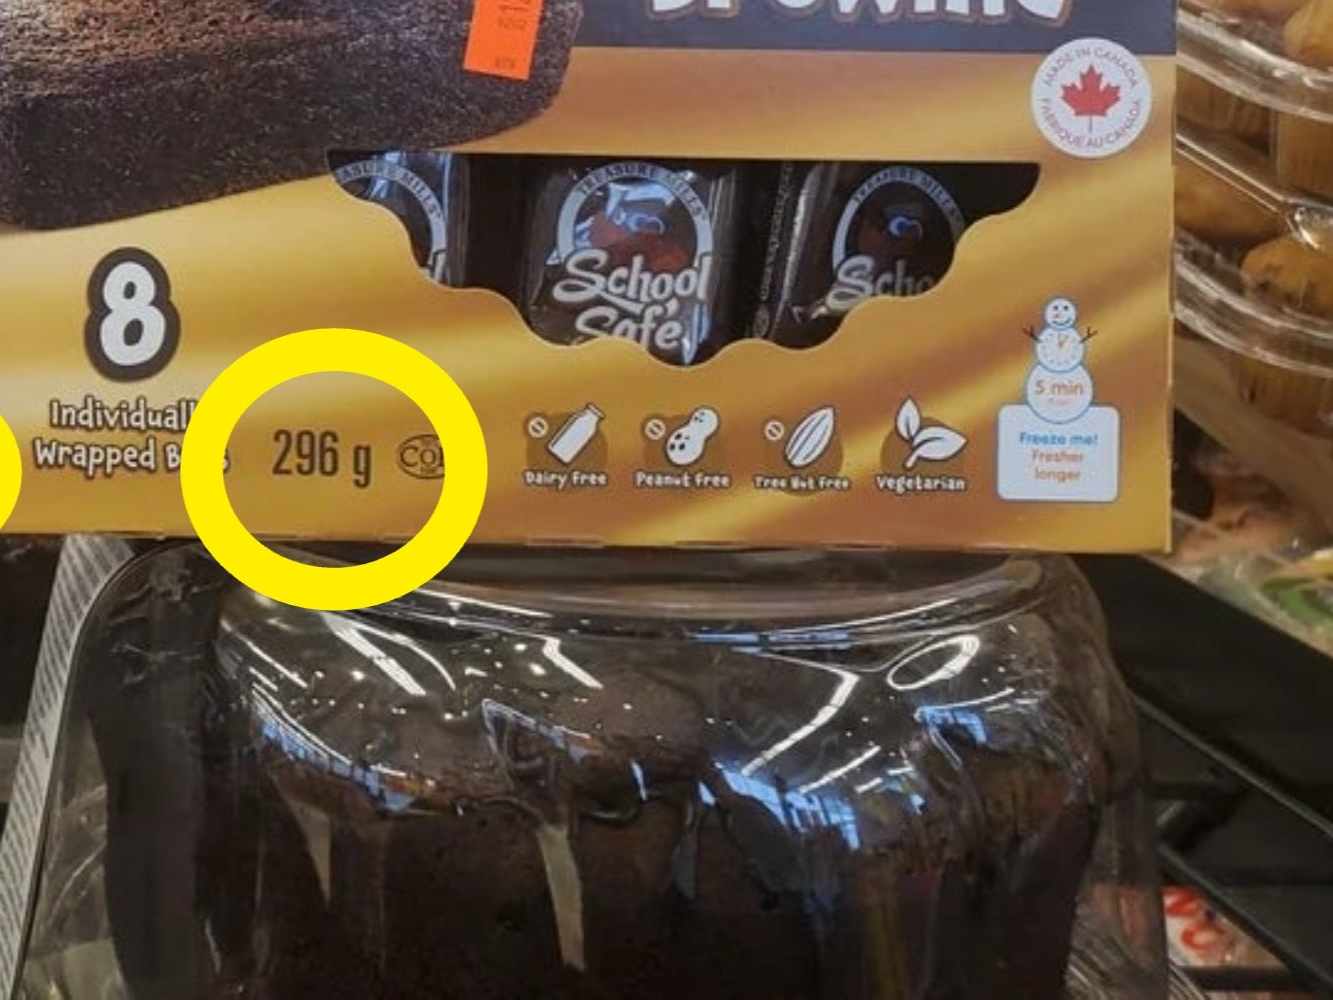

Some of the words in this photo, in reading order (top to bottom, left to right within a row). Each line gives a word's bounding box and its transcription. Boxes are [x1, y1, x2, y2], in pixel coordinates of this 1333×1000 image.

[552, 249, 713, 316] School
[91, 252, 174, 376] 8
[1019, 431, 1067, 446] Freeze
[34, 437, 156, 478] Wrapped
[271, 429, 340, 477] 296
[352, 444, 372, 488] g
[399, 444, 444, 467] CO
[525, 470, 566, 489] Dairy
[636, 470, 691, 488] Peanut
[876, 475, 966, 495] Vegetarian
